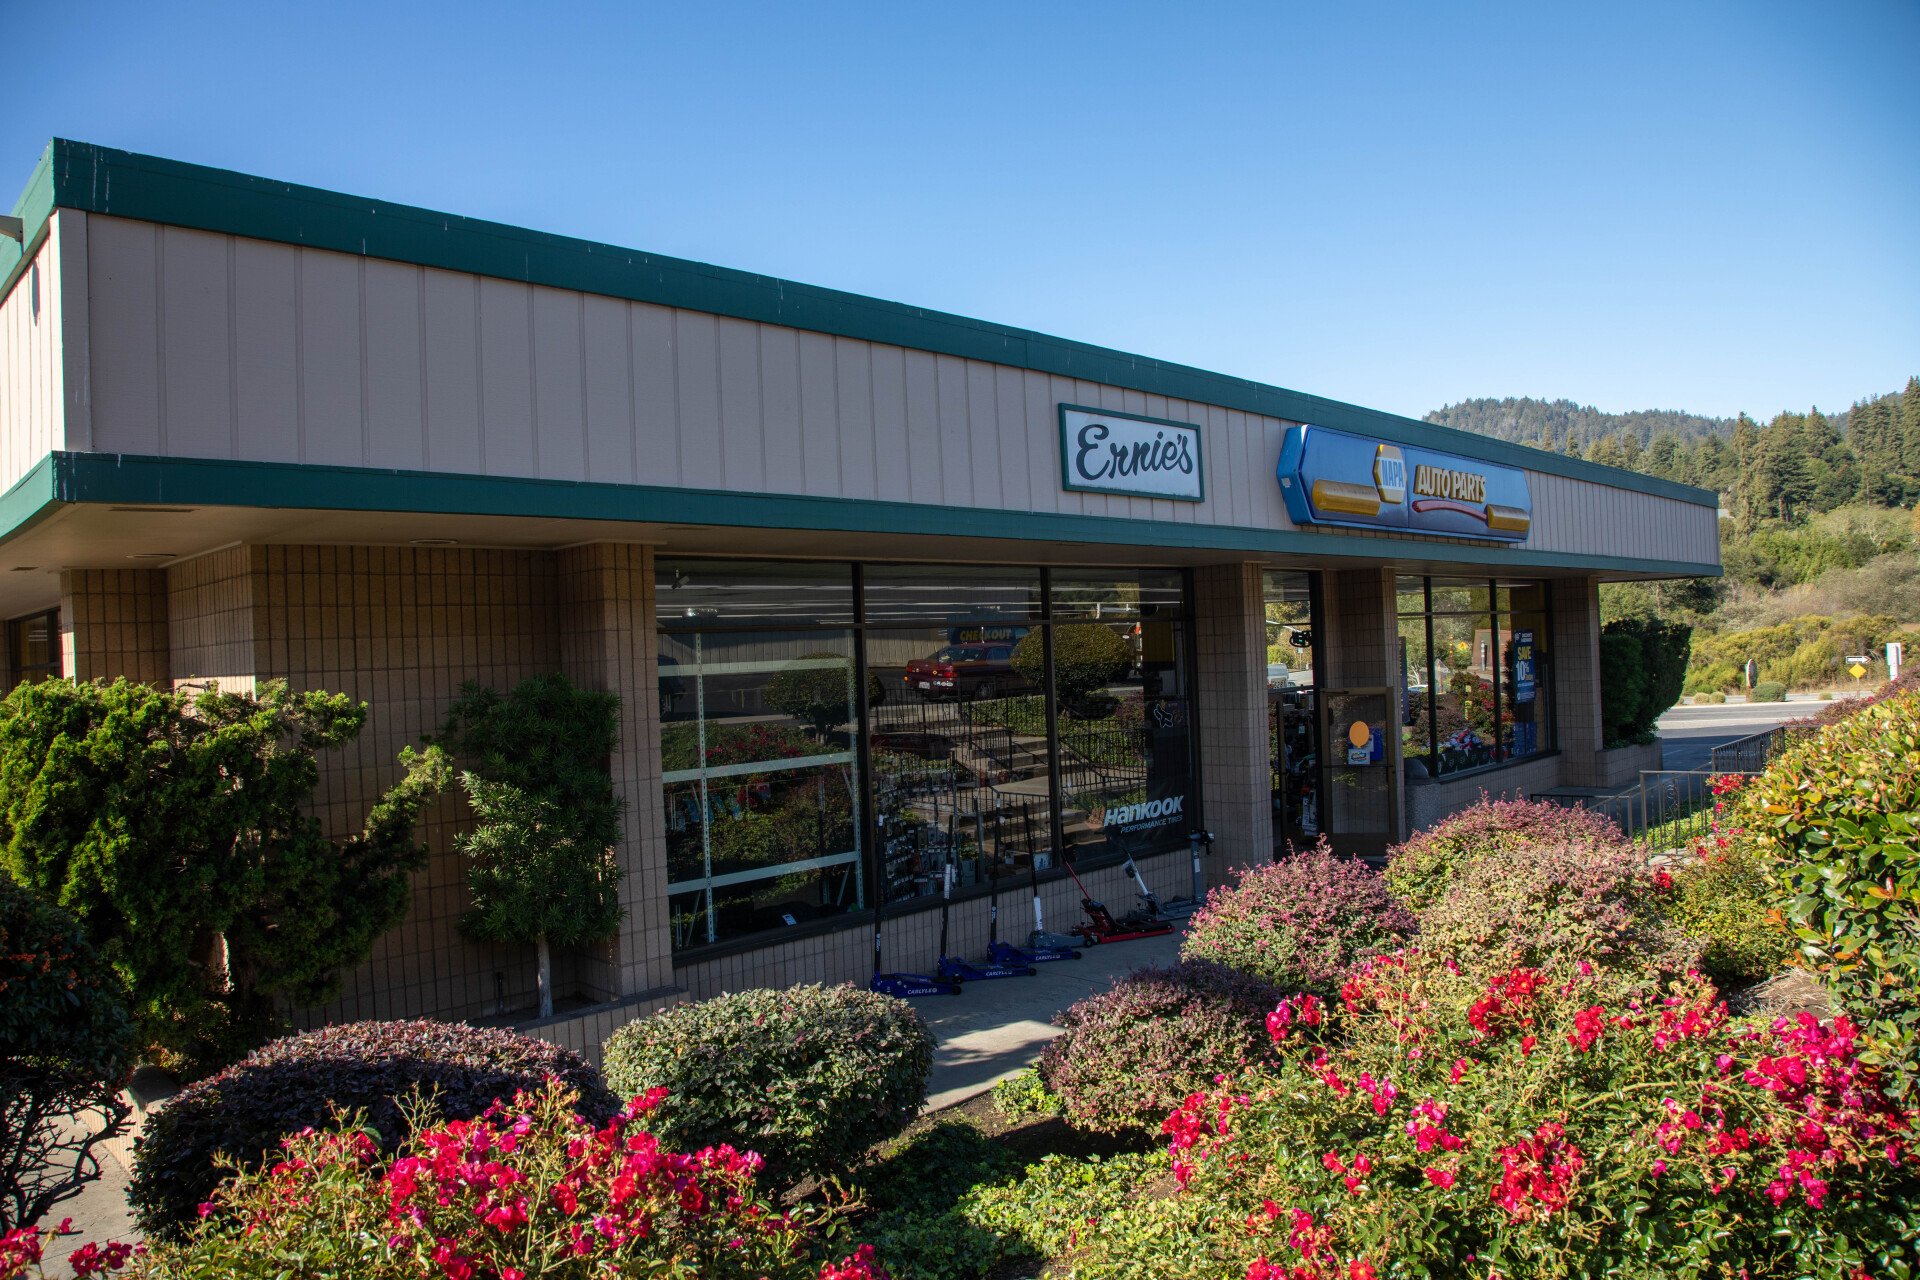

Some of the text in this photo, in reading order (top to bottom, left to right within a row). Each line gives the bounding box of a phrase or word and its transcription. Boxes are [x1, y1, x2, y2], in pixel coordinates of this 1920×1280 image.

[1076, 424, 1194, 482] Ernie's
[1381, 459, 1405, 489] NAPA
[1415, 464, 1487, 503] AUTO PARTS
[1517, 646, 1532, 660] SAVE
